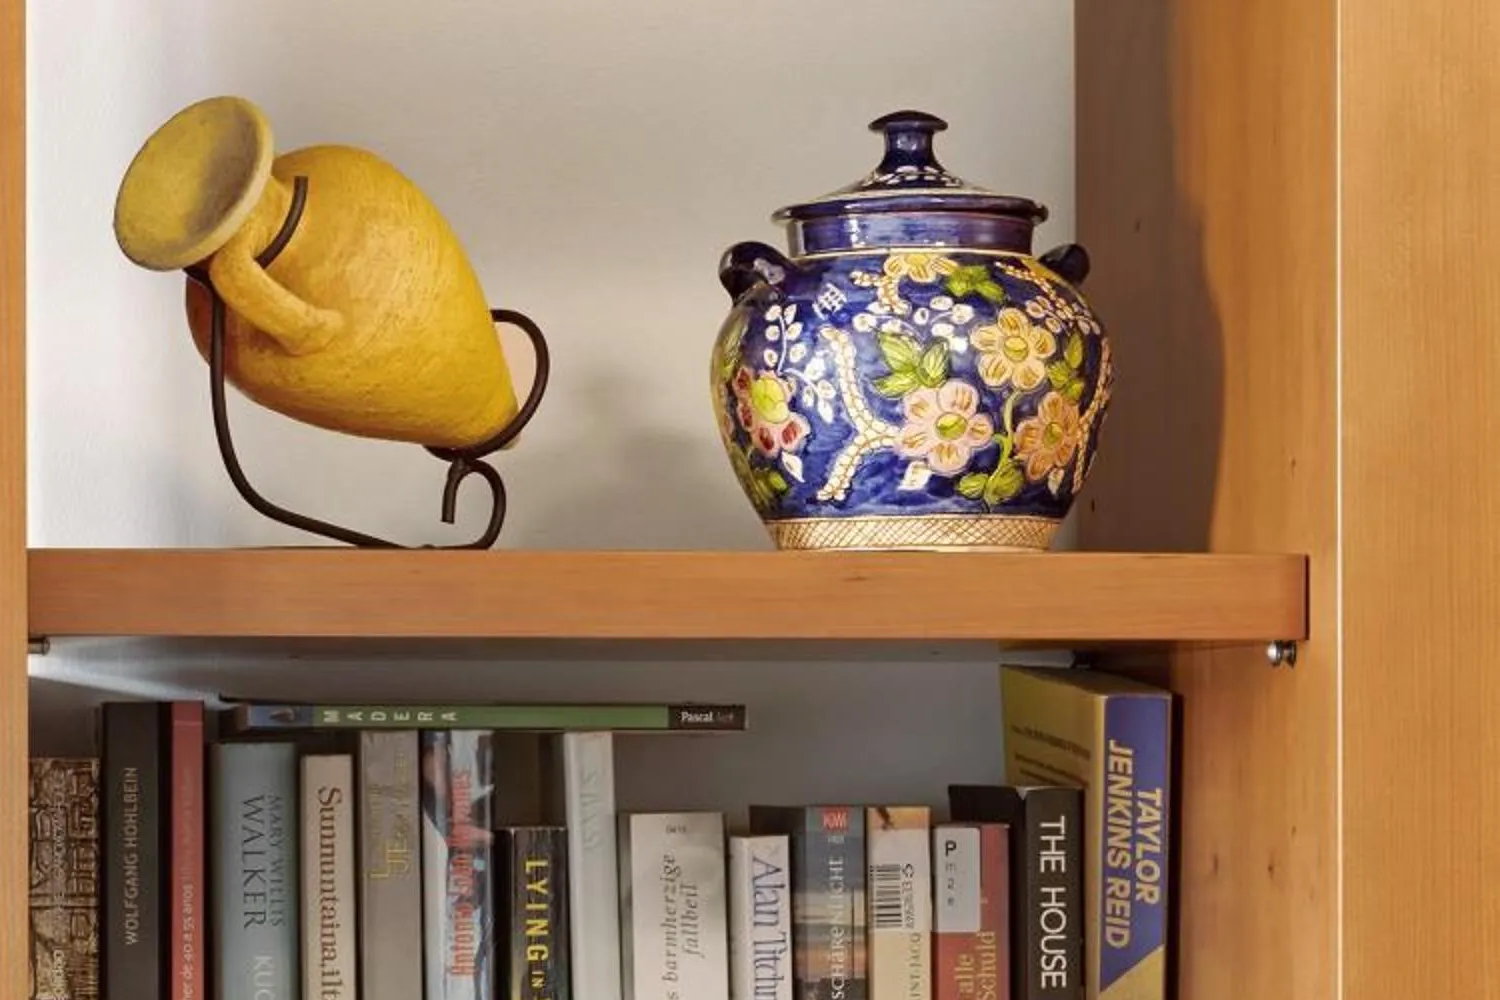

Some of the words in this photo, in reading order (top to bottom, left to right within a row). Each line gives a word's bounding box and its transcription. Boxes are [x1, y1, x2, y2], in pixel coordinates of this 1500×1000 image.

[323, 710, 457, 723] MADERA
[680, 711, 713, 722] Pascal
[124, 767, 138, 848] HOHLBEIN
[269, 795, 285, 850] MARY
[1106, 738, 1134, 870] JENKINS
[241, 794, 268, 929] WALKER
[945, 840, 957, 857] P
[1039, 815, 1067, 874] THE
[1135, 786, 1164, 905] TAYLOR
[124, 853, 139, 945] WOLFGANG
[182, 885, 193, 914] anos
[269, 858, 286, 927] WILLIS
[524, 858, 550, 962] LYING
[660, 854, 681, 983] barmherzige
[679, 884, 704, 959] fallbeil
[752, 854, 787, 928] Alan
[1104, 876, 1131, 950] REID
[180, 963, 193, 980] de
[953, 954, 974, 994] alle
[1040, 886, 1068, 990] HOUSE
[531, 969, 547, 989] IN
